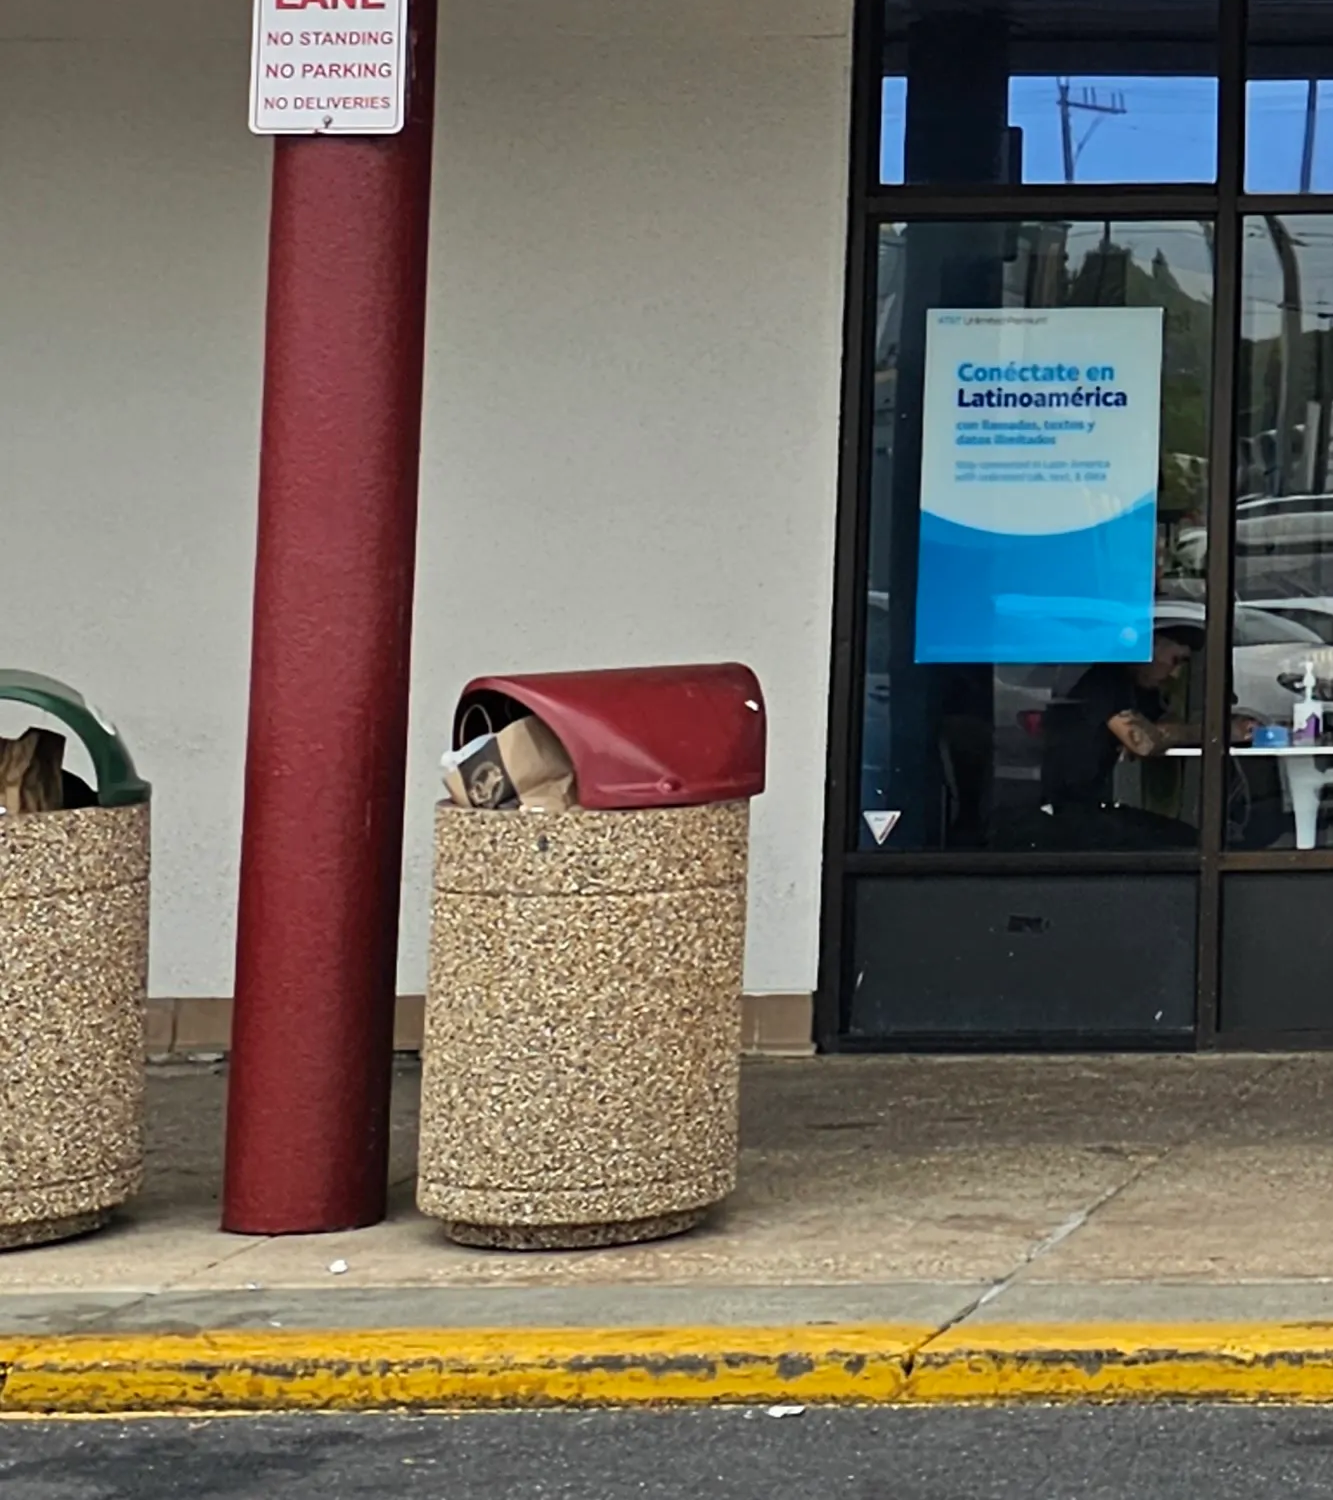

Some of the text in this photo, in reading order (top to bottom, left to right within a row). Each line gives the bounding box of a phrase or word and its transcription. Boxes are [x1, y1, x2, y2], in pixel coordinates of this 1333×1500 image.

[267, 31, 394, 46] NO STANDING
[265, 62, 392, 78] NO PARKING
[264, 96, 391, 110] NO DELIVERIES
[957, 361, 1115, 383] Conéctate en
[956, 386, 1129, 409] Latinoamérica
